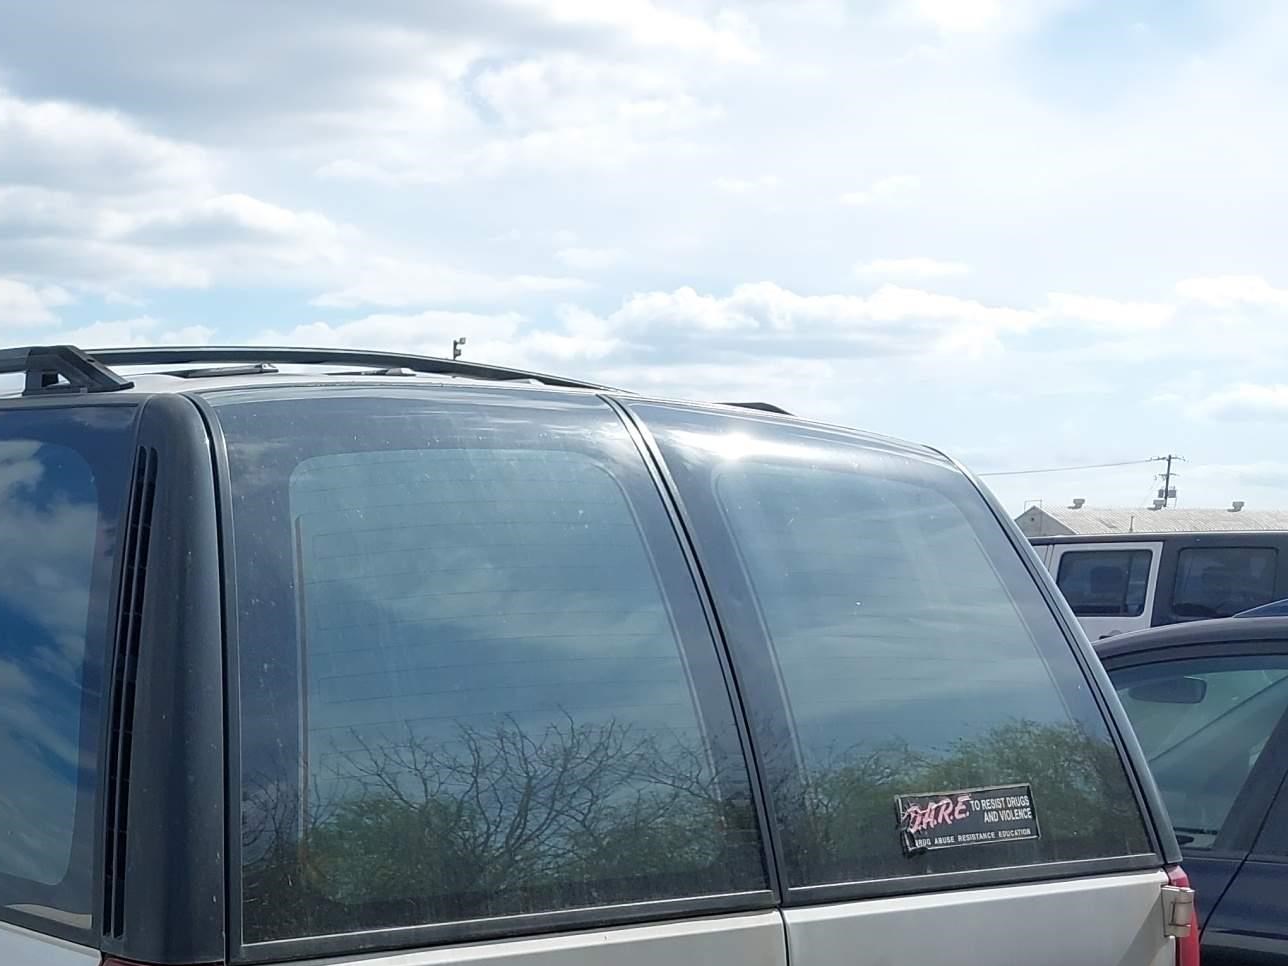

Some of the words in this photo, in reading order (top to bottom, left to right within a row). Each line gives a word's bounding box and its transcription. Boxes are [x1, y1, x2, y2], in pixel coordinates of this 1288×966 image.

[969, 799, 981, 811] TO
[981, 797, 1005, 810] RESIST
[1006, 795, 1030, 809] DRUGS
[983, 810, 999, 823] AND
[998, 808, 1033, 822] VIOLENCE
[934, 836, 955, 845] ABUSE
[957, 831, 996, 842] RESISTANCE
[998, 828, 1032, 838] EDUCATION
